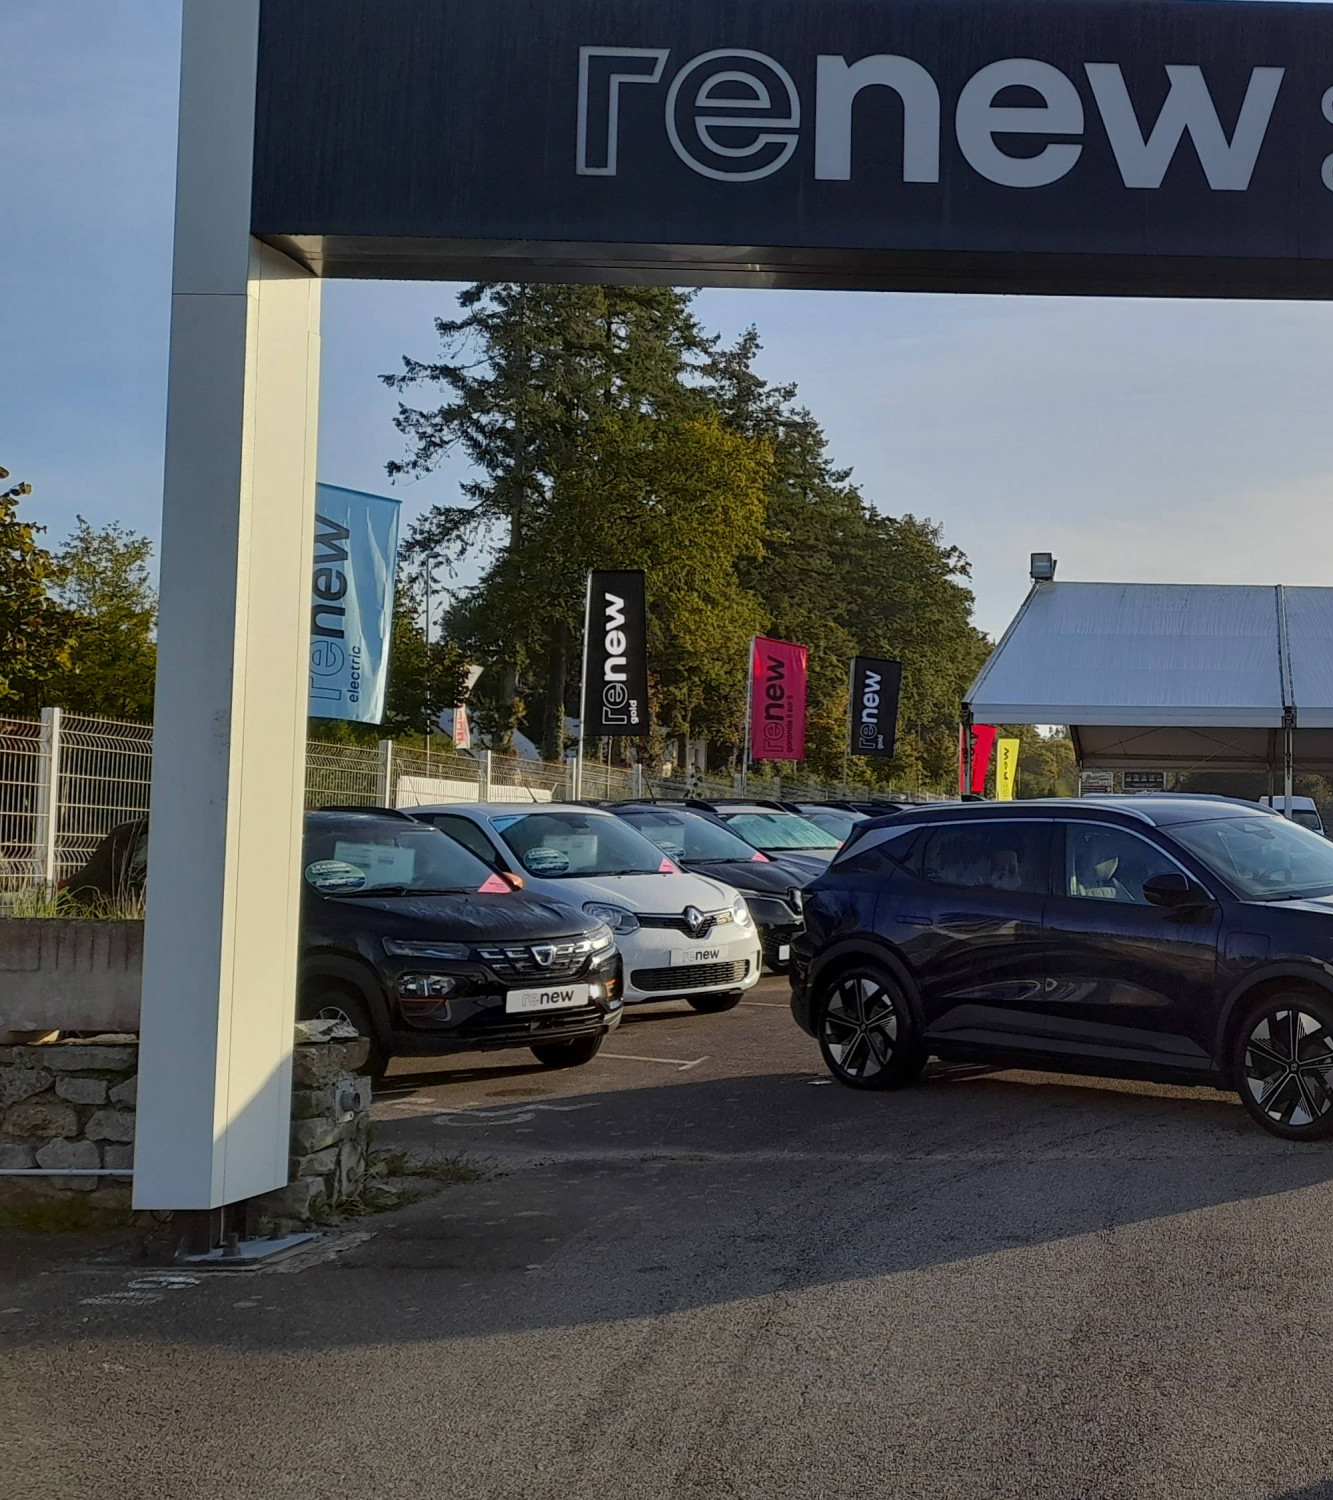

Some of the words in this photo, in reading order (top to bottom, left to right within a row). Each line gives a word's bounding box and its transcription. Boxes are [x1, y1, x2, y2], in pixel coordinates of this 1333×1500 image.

[575, 45, 1286, 191] renew
[308, 513, 350, 702] renew
[347, 645, 362, 703] electric
[602, 592, 629, 725] renew
[629, 700, 638, 725] gold
[763, 654, 786, 753] renew
[785, 719, 794, 753] garantie
[859, 670, 882, 749] renew
[681, 949, 720, 963] renew
[521, 990, 575, 1008] renew
